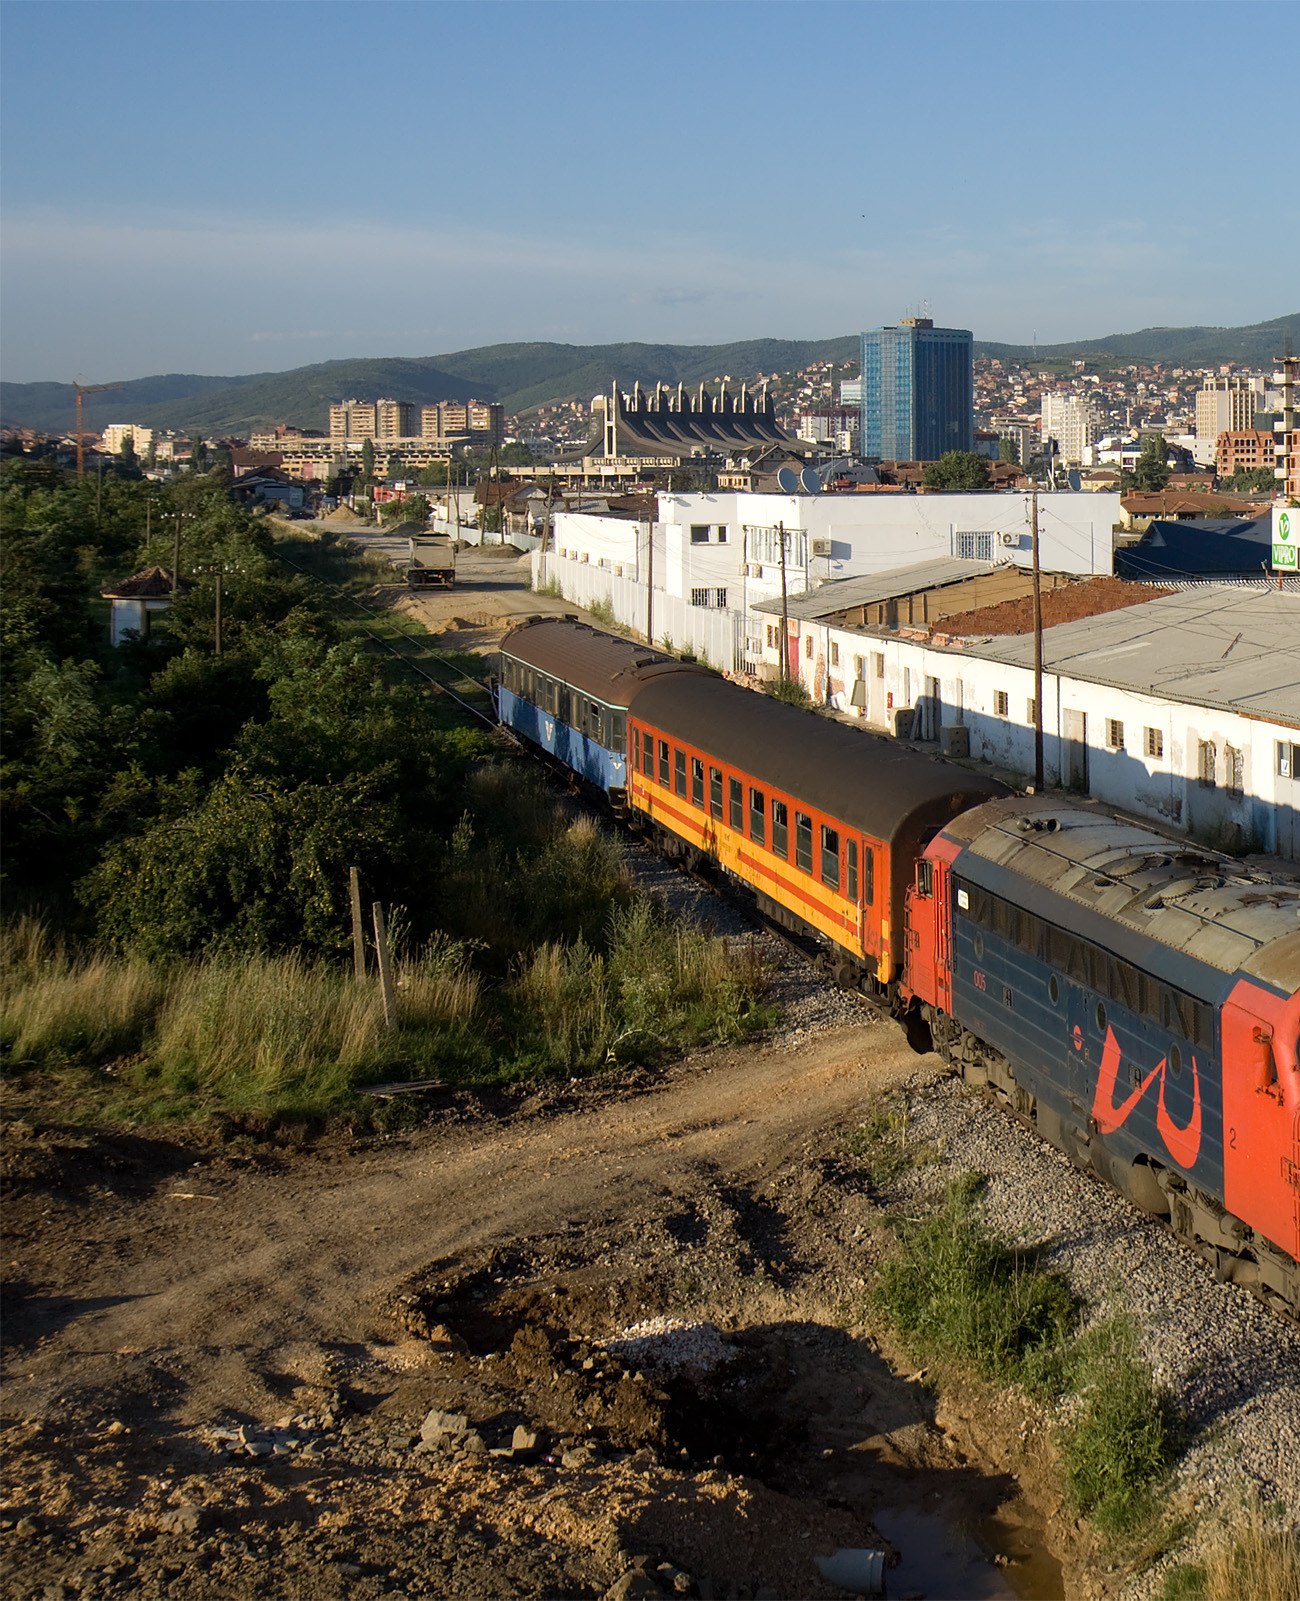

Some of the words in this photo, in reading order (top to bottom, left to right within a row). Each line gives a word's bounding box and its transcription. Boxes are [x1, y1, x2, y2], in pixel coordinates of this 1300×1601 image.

[1273, 545, 1294, 564] VIPRO
[973, 970, 986, 992] 005
[1229, 1127, 1237, 1150] 2
